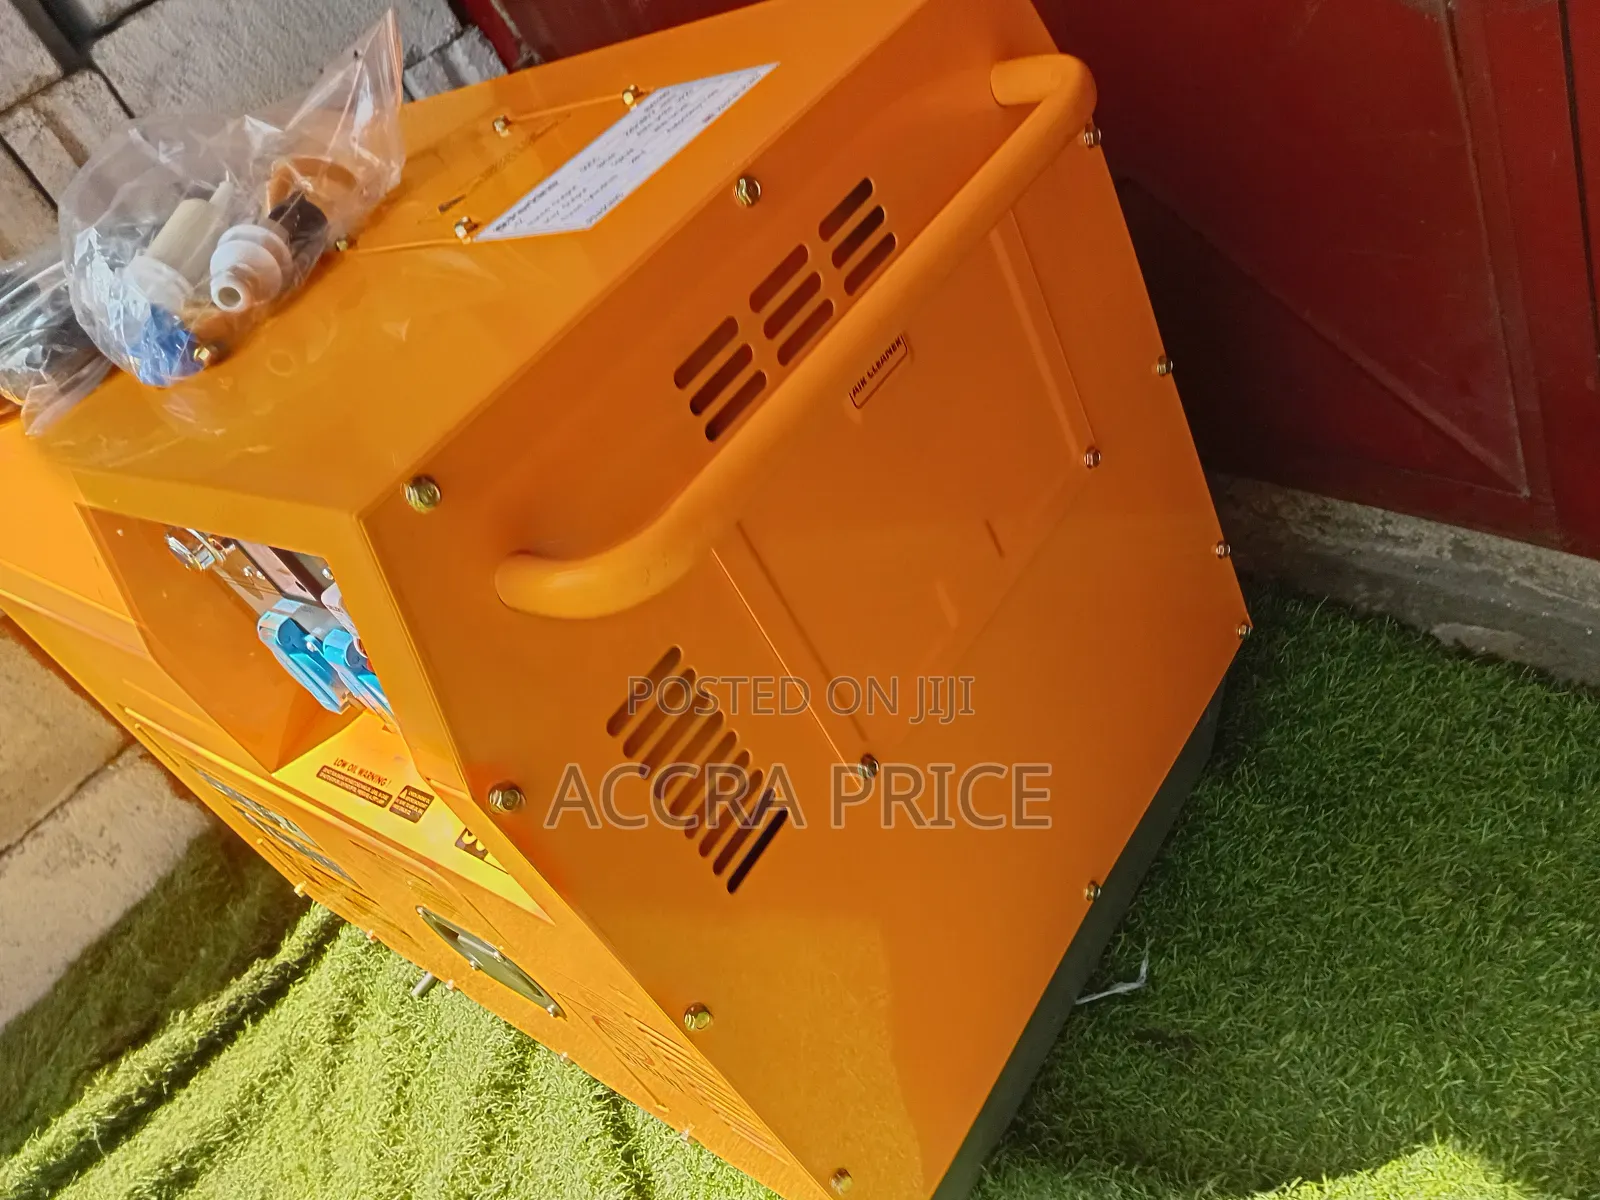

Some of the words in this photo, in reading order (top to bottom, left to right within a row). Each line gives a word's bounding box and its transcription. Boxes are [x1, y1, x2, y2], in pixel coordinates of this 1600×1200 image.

[852, 376, 867, 398] AIR
[867, 336, 902, 379] CLEANER
[333, 757, 347, 768] LOW
[347, 763, 357, 774] OIL
